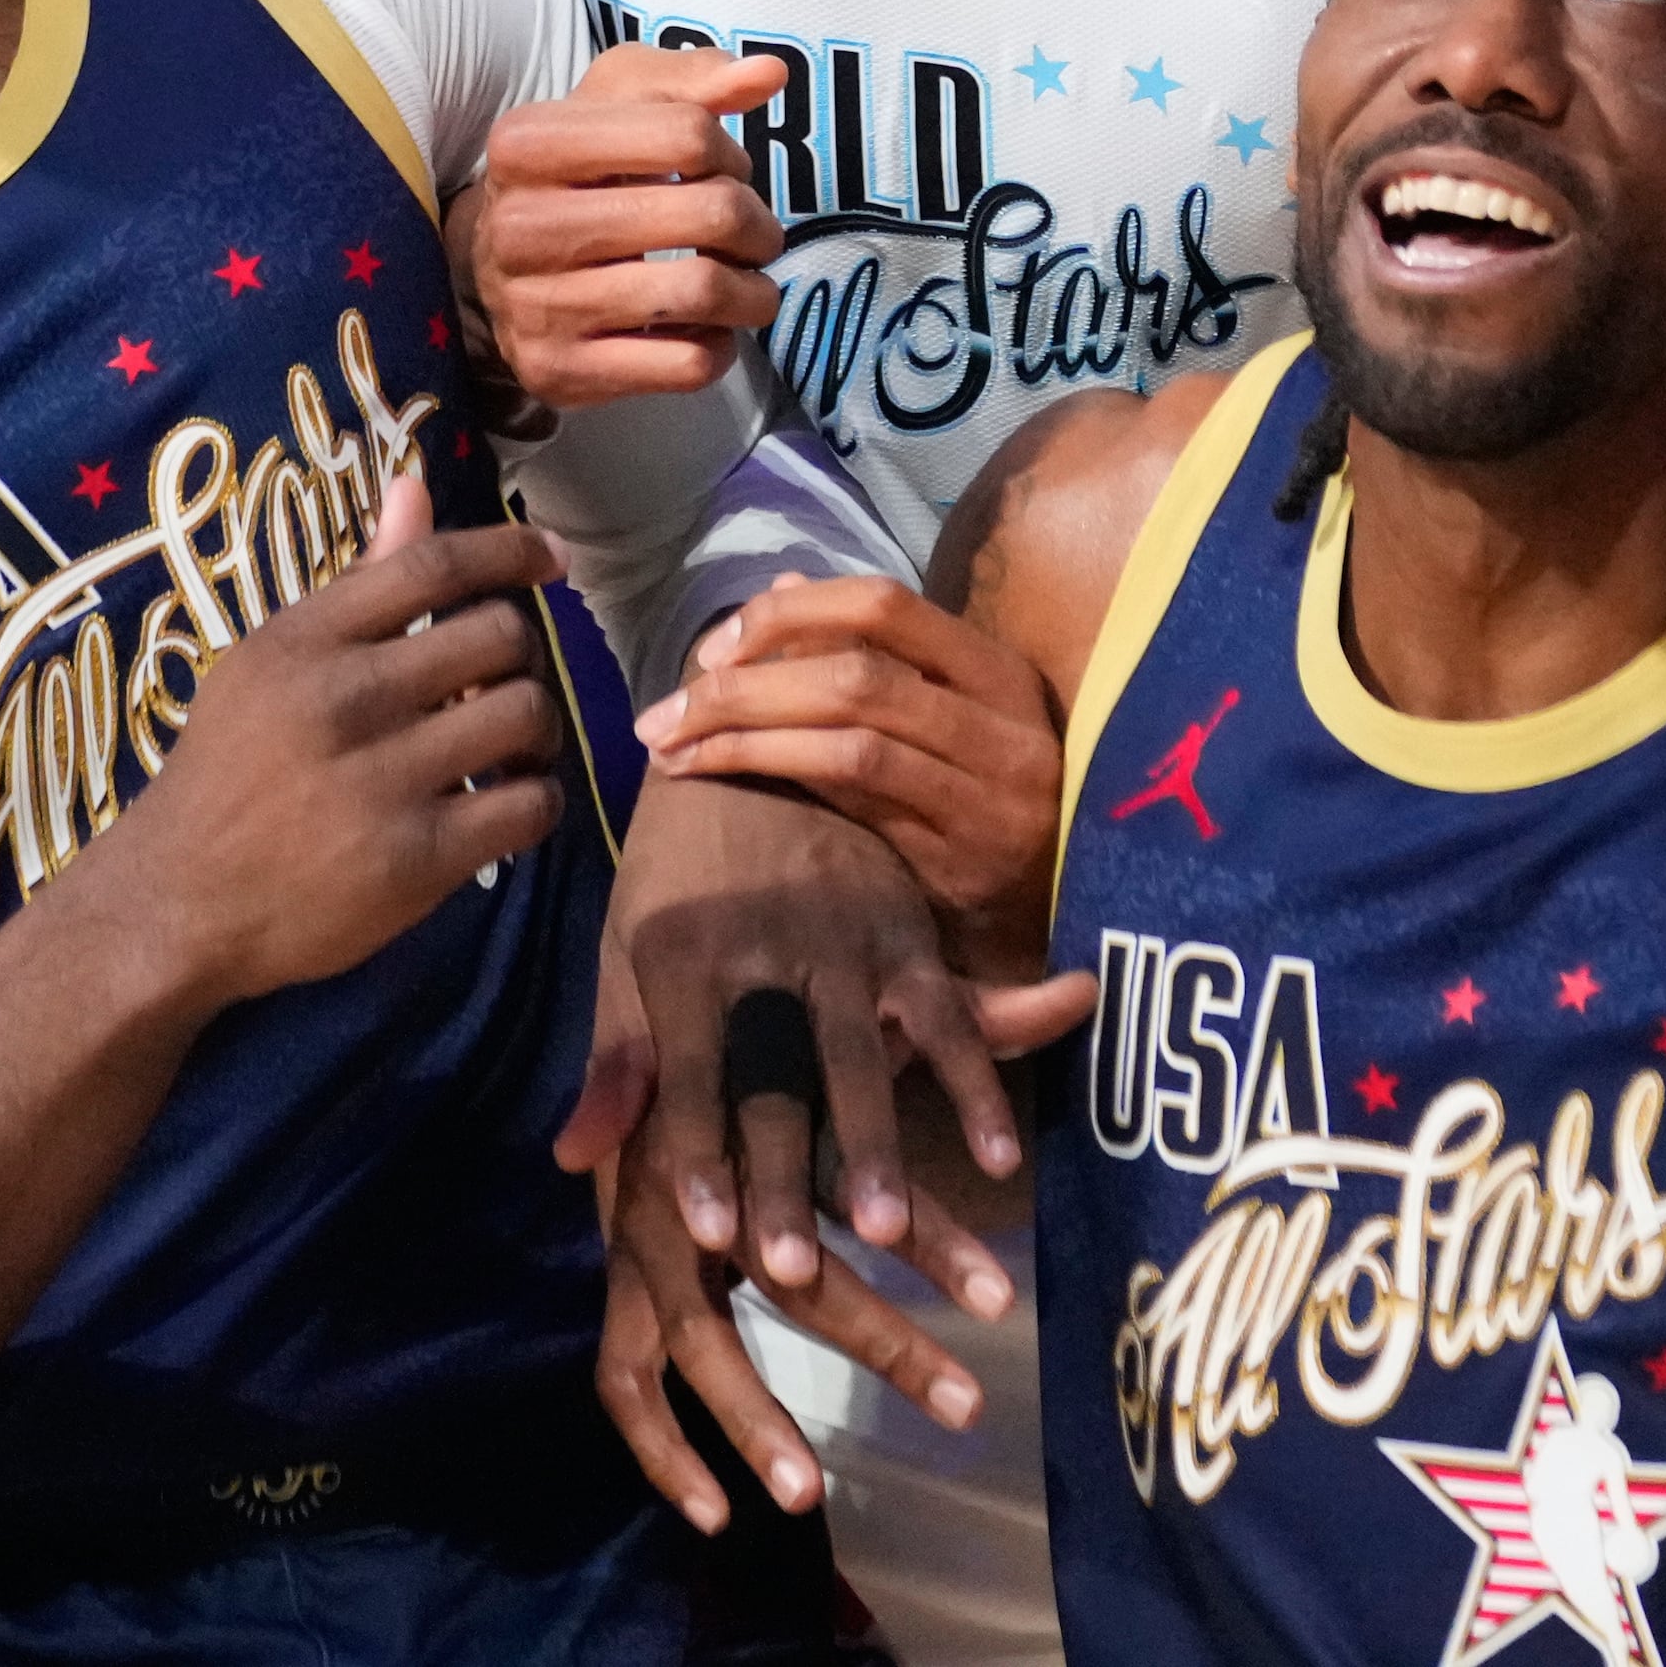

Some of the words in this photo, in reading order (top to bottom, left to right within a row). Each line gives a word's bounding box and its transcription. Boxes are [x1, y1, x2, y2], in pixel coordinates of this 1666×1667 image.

[783, 181, 1277, 431] Stars
[1090, 927, 1339, 1174] USA
[1113, 1188, 1333, 1506] All
